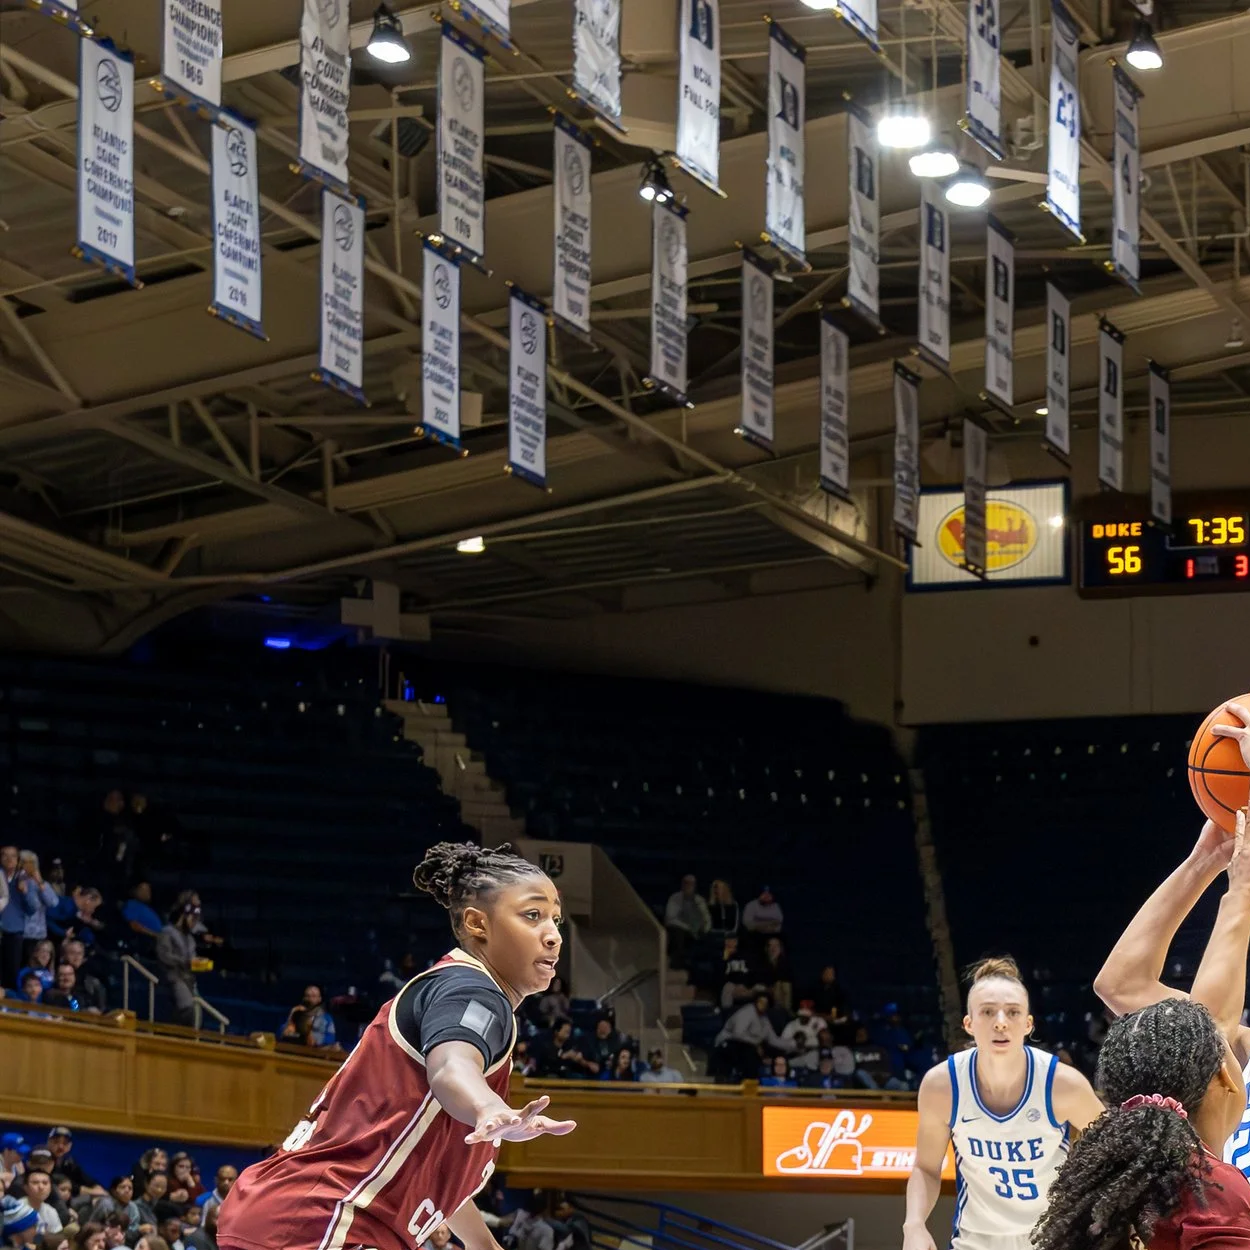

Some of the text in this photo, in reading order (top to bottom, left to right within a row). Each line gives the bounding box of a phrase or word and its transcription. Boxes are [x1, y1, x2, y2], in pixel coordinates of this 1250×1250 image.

[1092, 522, 1142, 538] DUKE
[1188, 516, 1245, 545] 7:35
[1107, 545, 1142, 575] 56
[1185, 558, 1195, 579] 1
[1234, 554, 1249, 577] 3
[871, 1150, 918, 1168] STIH
[967, 1136, 1045, 1163] DUKE
[988, 1165, 1040, 1201] 35
